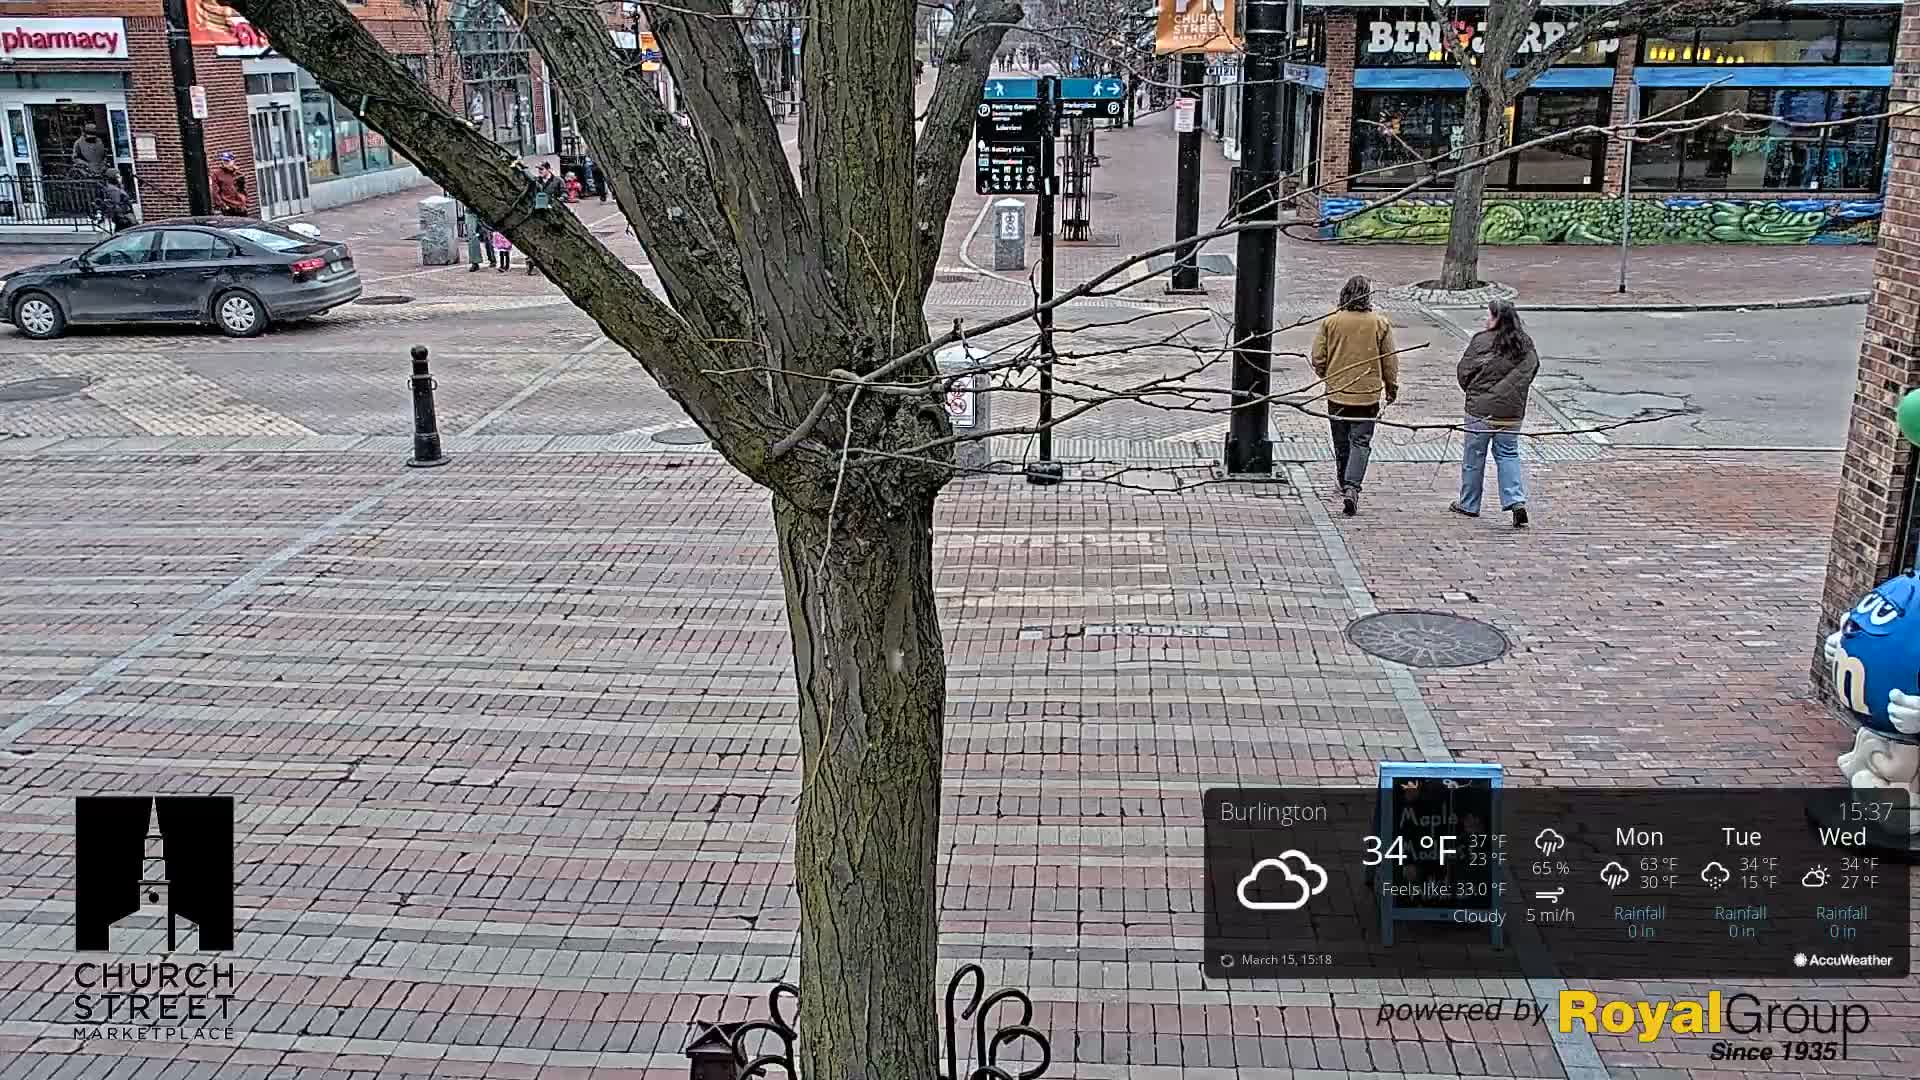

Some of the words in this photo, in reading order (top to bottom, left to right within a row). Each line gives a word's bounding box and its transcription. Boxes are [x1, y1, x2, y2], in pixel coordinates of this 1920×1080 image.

[1, 27, 119, 54] pharmacy
[1173, 24, 1222, 34] STREE
[1367, 20, 1442, 53] BEN
